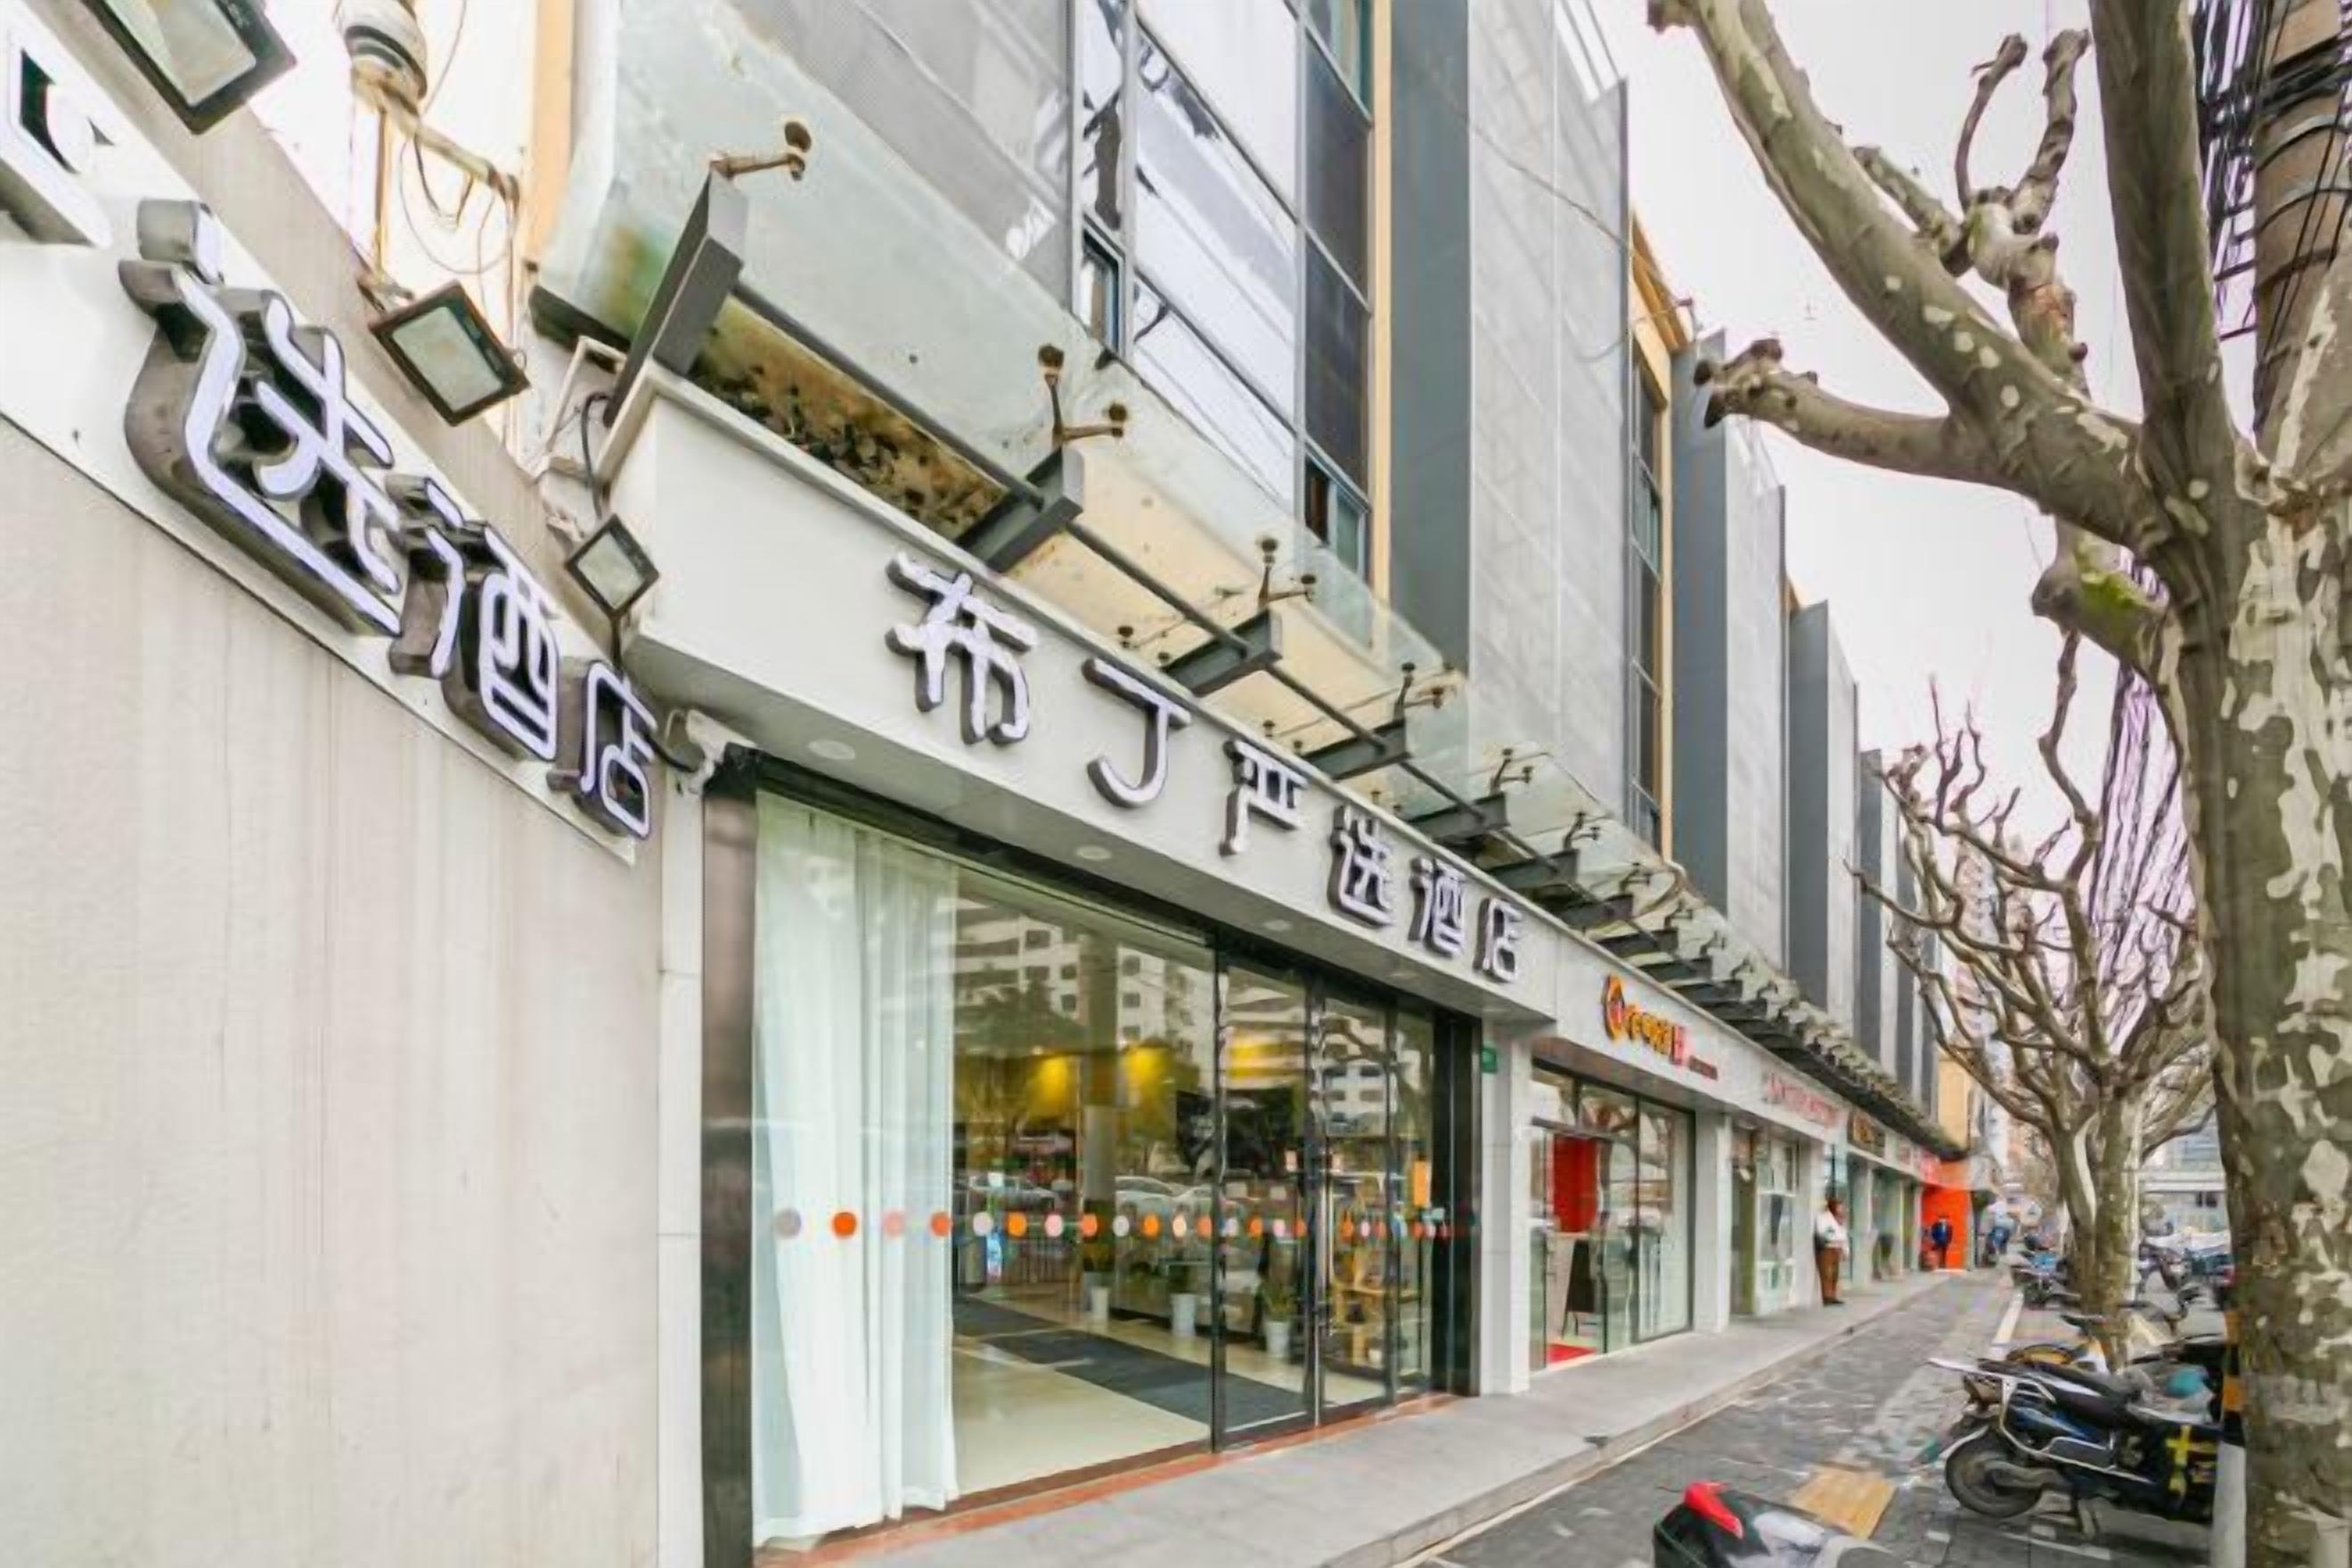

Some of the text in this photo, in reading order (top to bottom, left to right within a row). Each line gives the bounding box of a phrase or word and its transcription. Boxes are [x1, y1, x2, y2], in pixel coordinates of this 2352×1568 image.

[886, 548, 1523, 983] 布丁严选酒店
